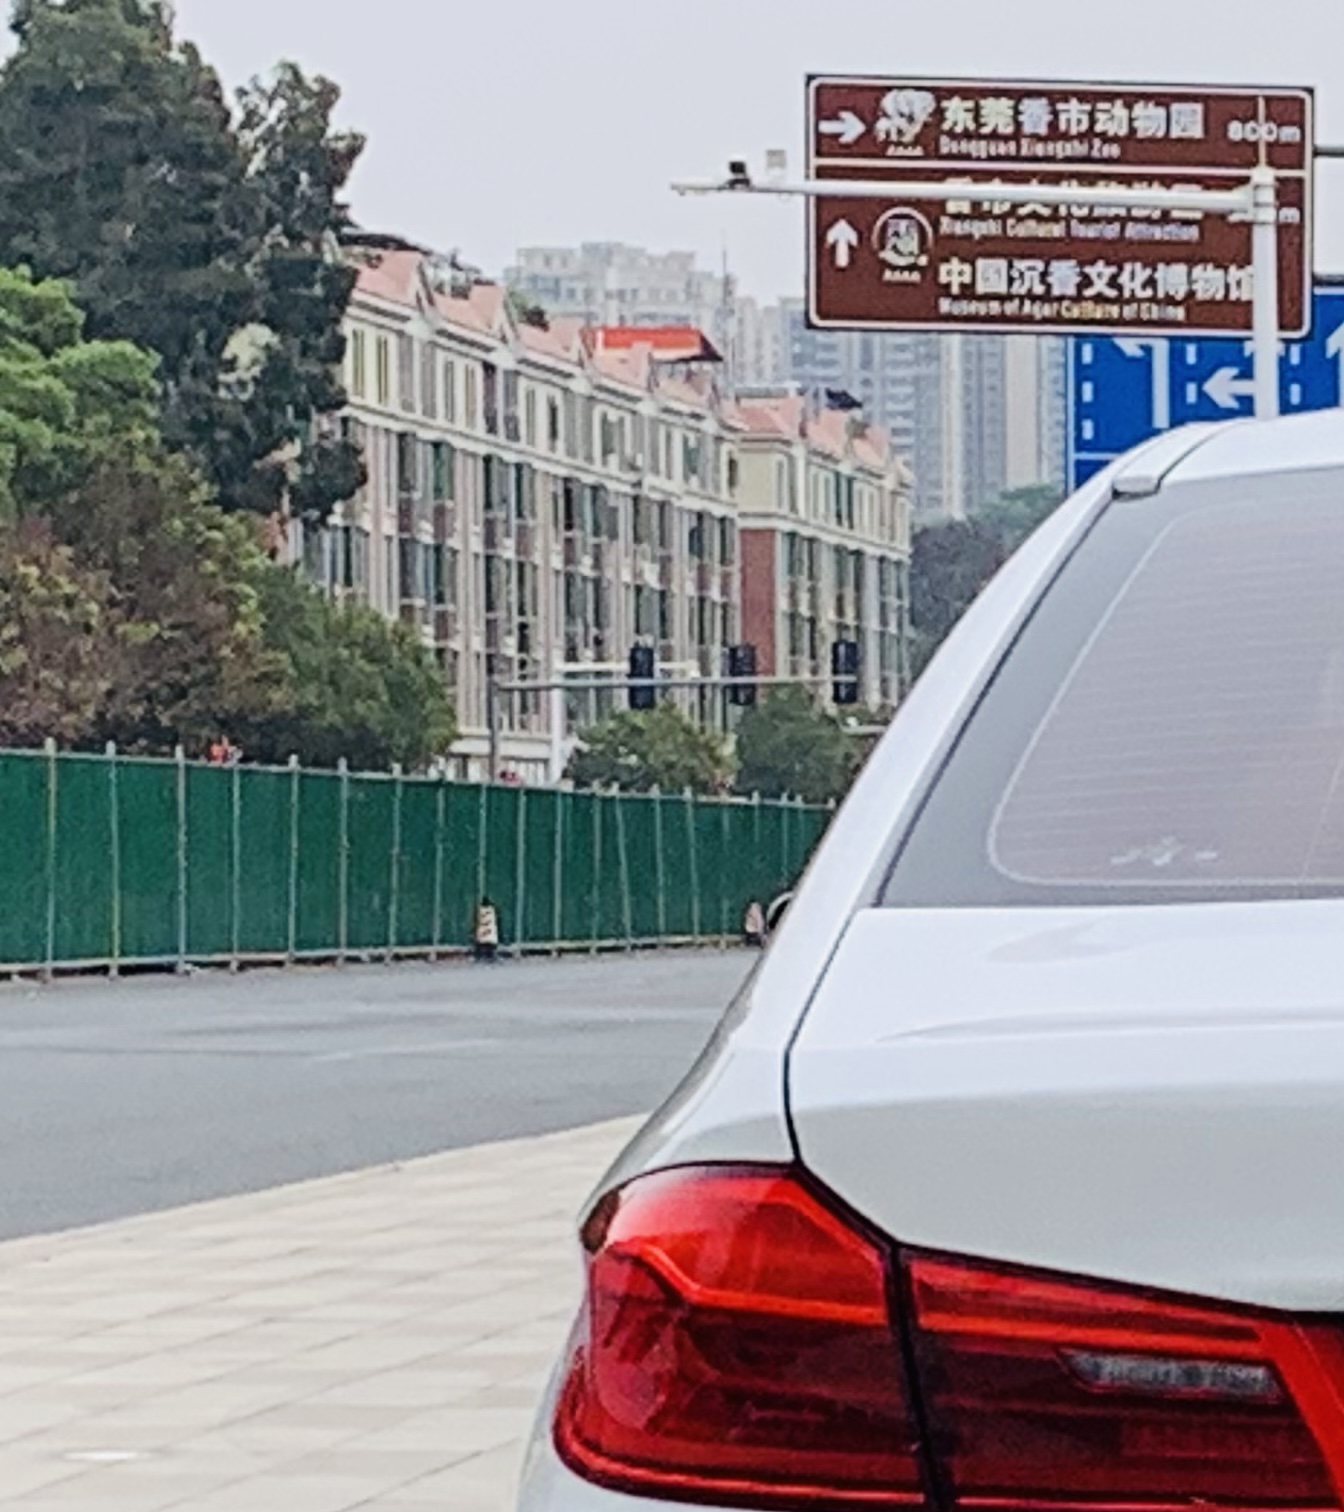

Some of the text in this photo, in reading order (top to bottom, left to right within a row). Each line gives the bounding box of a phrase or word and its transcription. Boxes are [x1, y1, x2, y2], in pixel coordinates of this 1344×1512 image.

[940, 96, 1204, 140] 东莞香市动物园
[1091, 138, 1121, 159] Zoo
[938, 257, 1253, 302] 中国沉香文化博物馆
